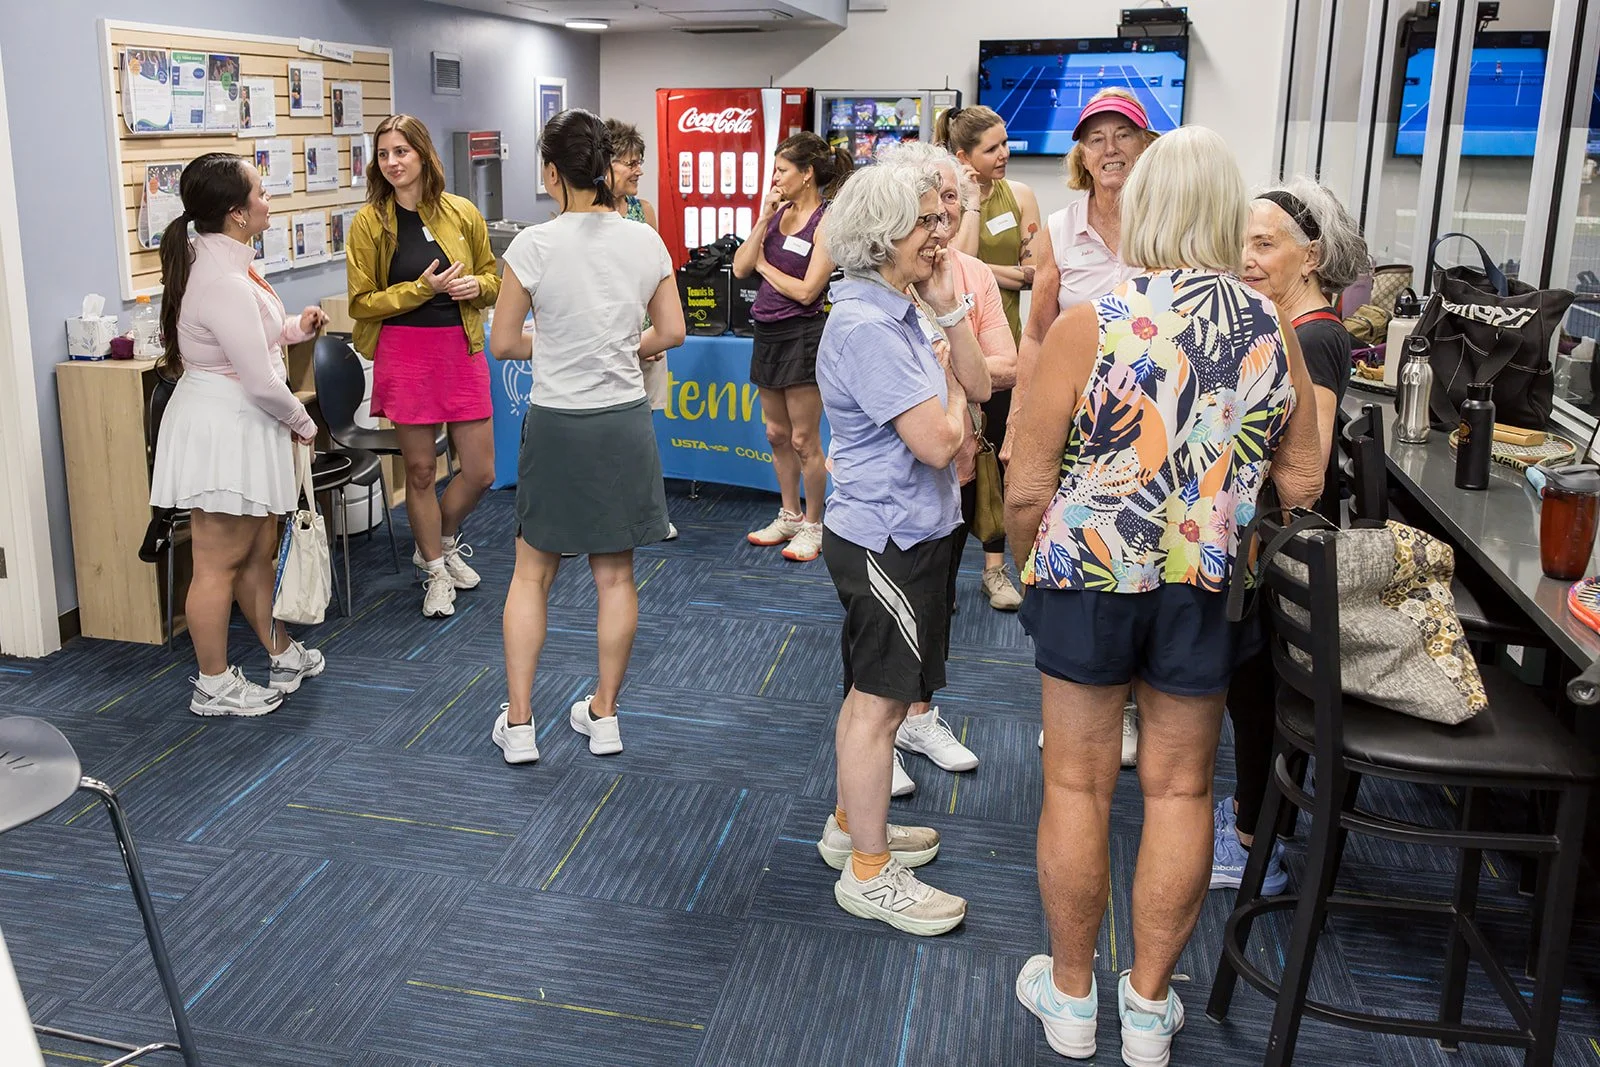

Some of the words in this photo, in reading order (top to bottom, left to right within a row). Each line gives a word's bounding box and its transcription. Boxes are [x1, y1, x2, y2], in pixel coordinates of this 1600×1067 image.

[687, 287, 707, 296] Tennis
[708, 287, 714, 296] is
[688, 297, 717, 308] booming.
[147, 335, 158, 344] ZE
[664, 371, 766, 424] tenn
[671, 438, 709, 451] USTA
[735, 447, 773, 463] COLO
